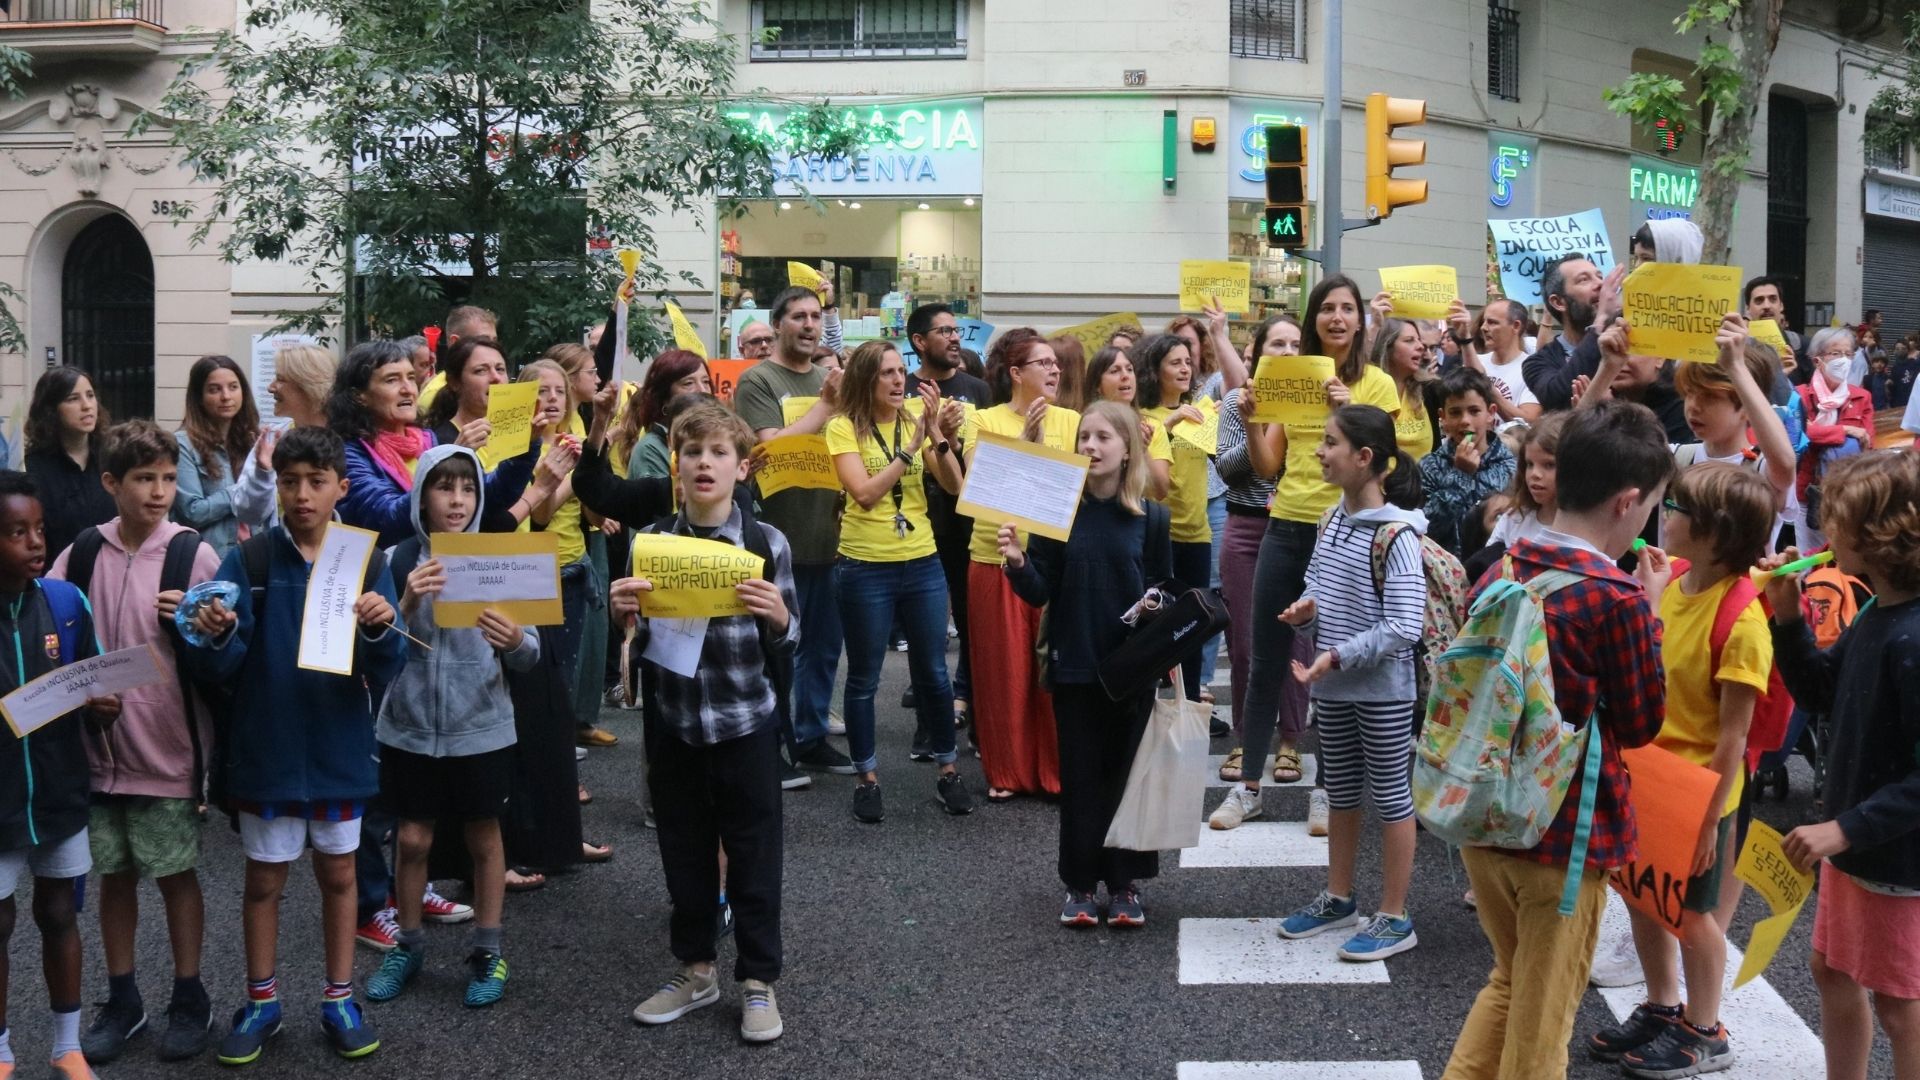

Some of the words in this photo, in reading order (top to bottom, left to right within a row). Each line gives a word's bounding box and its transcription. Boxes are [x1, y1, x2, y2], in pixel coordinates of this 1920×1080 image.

[1125, 71, 1145, 84] 367
[1508, 217, 1581, 235] ESCOLA
[1500, 232, 1605, 256] INCLUSIVA
[1501, 260, 1513, 273] de
[1518, 250, 1607, 277] QUAT
[1184, 275, 1232, 287] L'EDUCACIÓ
[1234, 279, 1246, 288] NO
[1386, 280, 1440, 292] L'EDUCACIÓ
[1443, 284, 1455, 294] NO
[1627, 293, 1704, 314] L'EDUCACIÓ
[1709, 299, 1729, 316] NO
[467, 561, 500, 572] INCLUSIVA
[501, 562, 510, 571] de
[640, 554, 731, 573] L'EDUCACIÓ
[735, 557, 757, 568] NO
[319, 588, 333, 630] INCLUSIVA
[328, 574, 336, 587] de
[46, 666, 87, 689] INCLUSIVA
[88, 662, 98, 672] de
